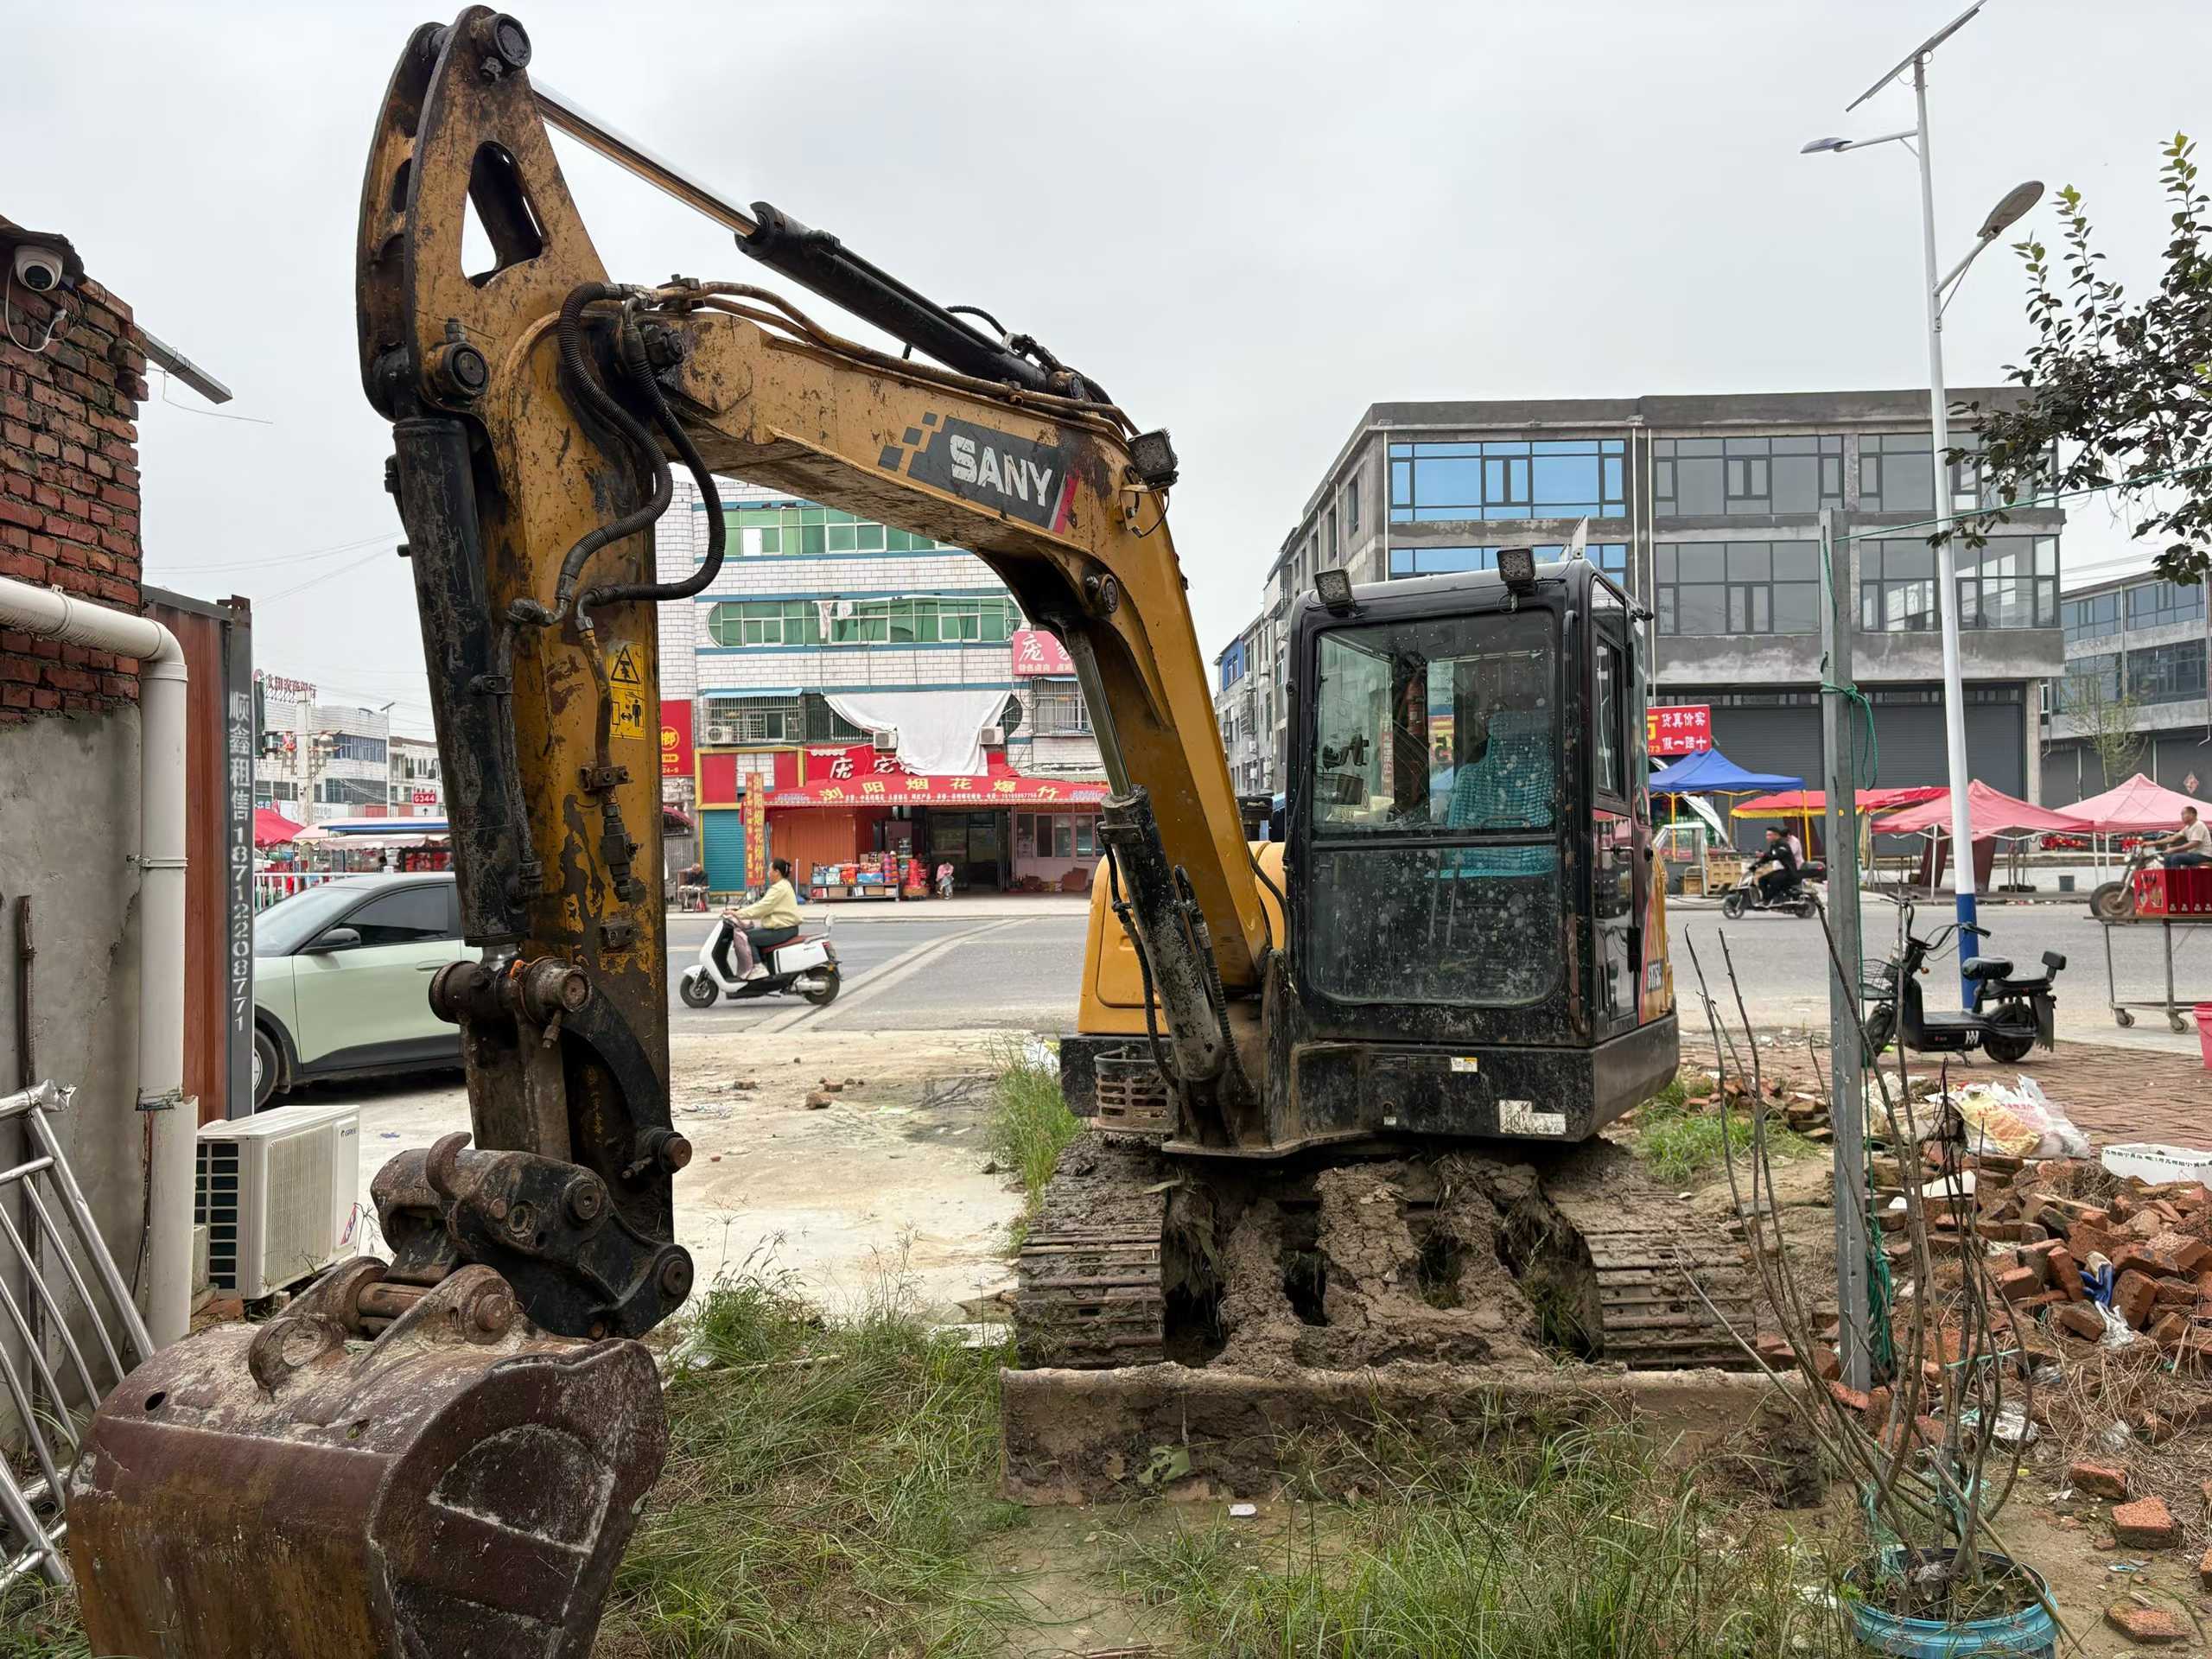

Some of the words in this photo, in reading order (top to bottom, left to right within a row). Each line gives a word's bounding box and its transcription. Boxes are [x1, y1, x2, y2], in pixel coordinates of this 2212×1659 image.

[950, 434, 1052, 507] SANY
[1662, 712, 1706, 728] 货真价实
[1662, 735, 1707, 751] 假一赔十
[819, 778, 1058, 801] 浏阳烟花爆竹
